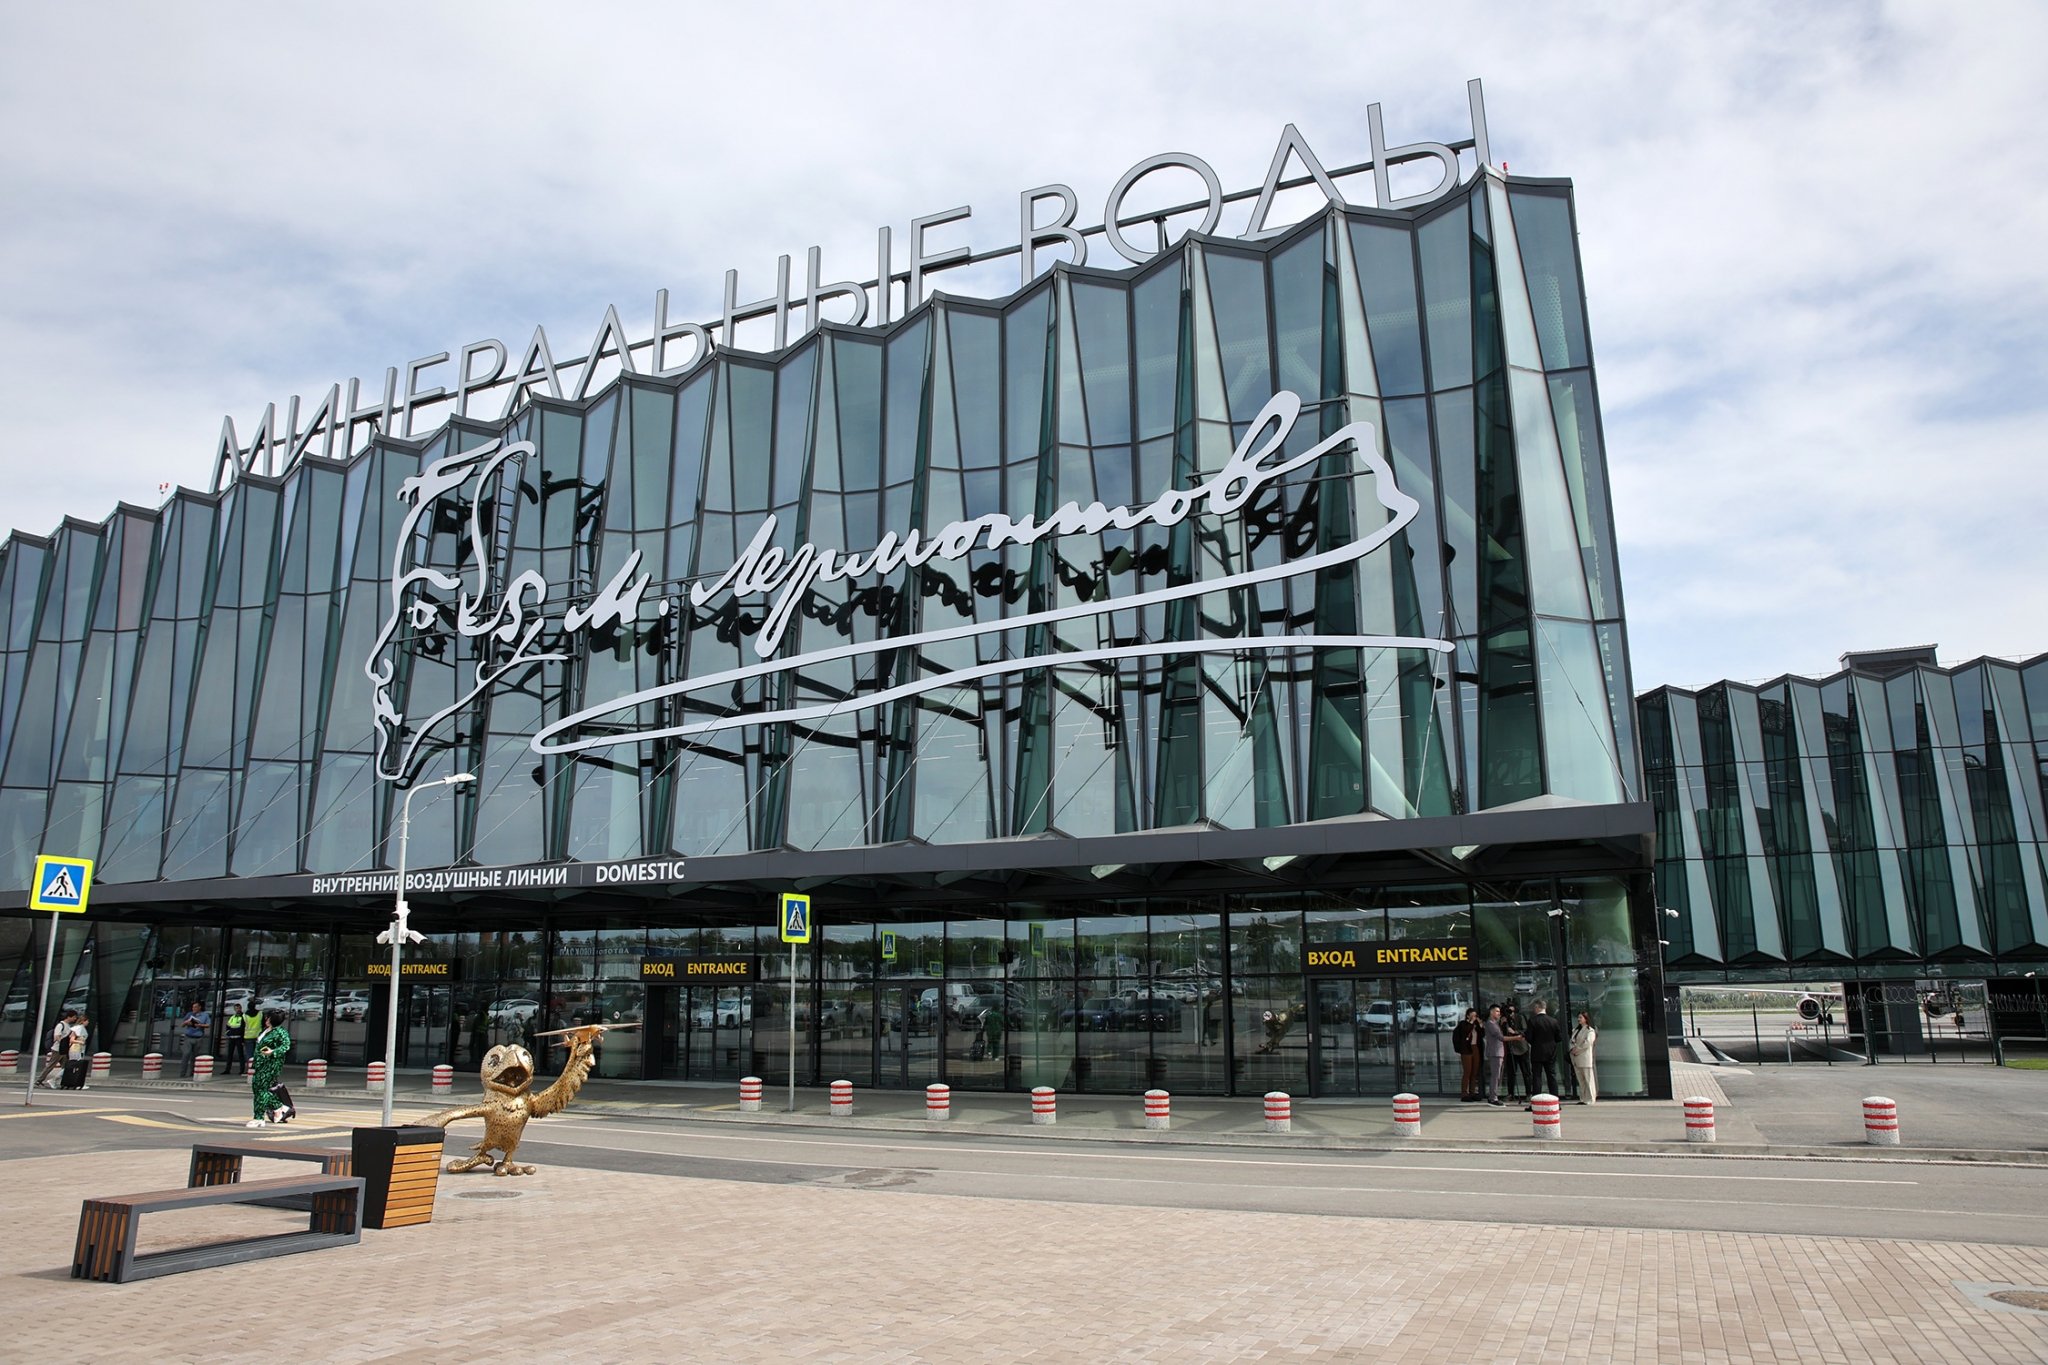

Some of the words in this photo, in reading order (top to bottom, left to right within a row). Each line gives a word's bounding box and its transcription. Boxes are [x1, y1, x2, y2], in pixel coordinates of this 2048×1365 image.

[210, 205, 972, 494] МИНЕРАЛЬНЫЕ
[1019, 77, 1491, 286] ВОДЫ
[405, 870, 502, 892] ВОЗДУШНЫЕ
[505, 867, 567, 886] ЛИНИИ
[596, 861, 685, 883] DOMESTIC
[1308, 950, 1356, 968] ВХОД
[1376, 946, 1469, 964] ENTRANCE
[367, 964, 392, 976] ВХОД
[401, 963, 449, 975] ENTRANCE
[643, 963, 674, 977] ВХОД
[687, 962, 748, 974] ENTRANCE
